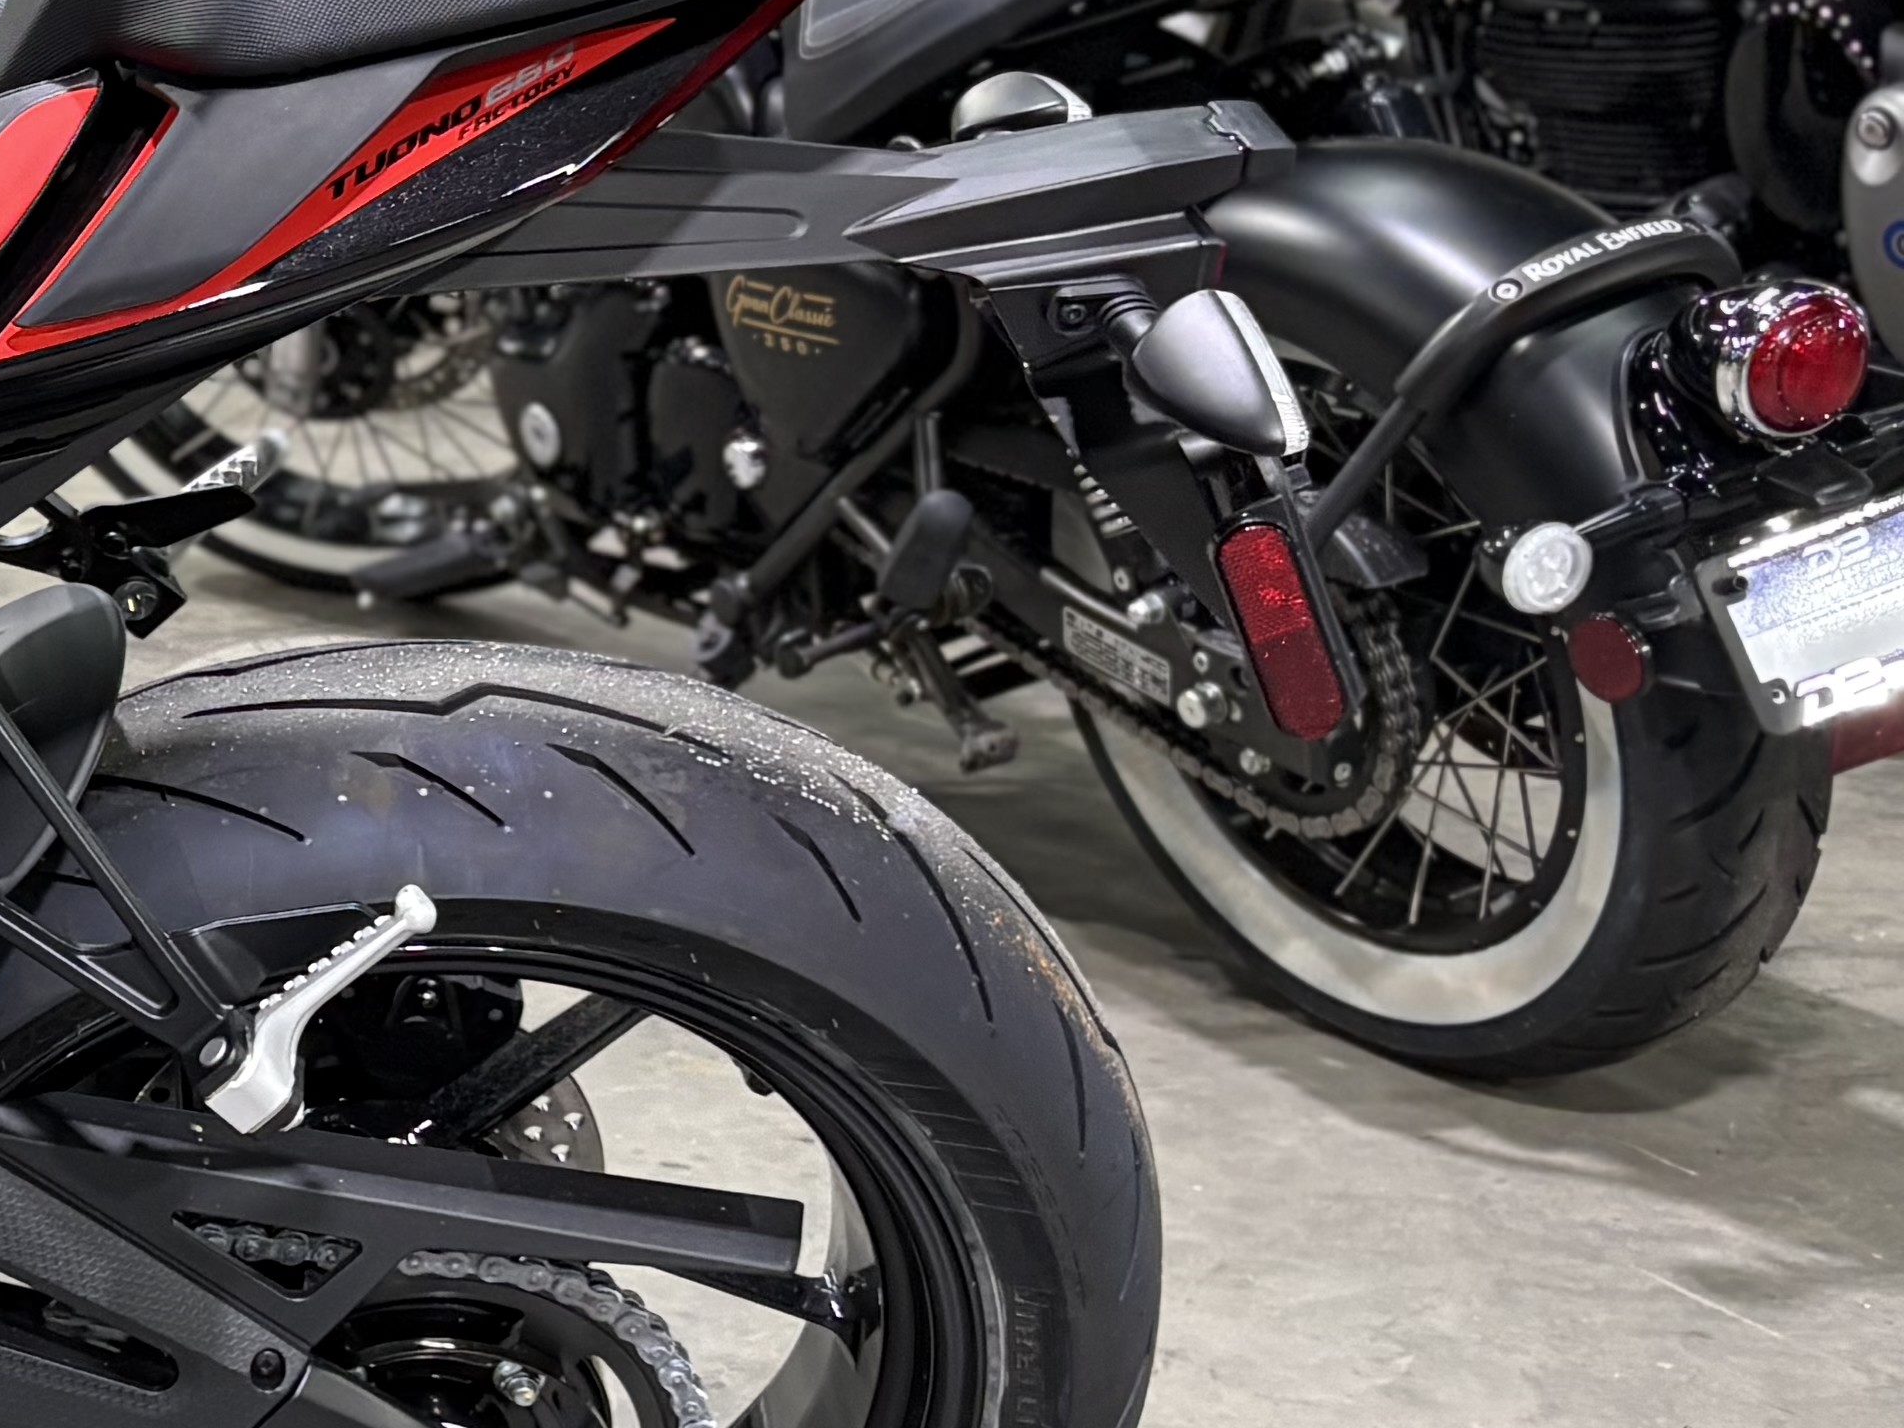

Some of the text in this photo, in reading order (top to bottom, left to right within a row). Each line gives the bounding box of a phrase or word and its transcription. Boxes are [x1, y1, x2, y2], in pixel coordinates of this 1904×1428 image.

[457, 61, 576, 141] FACTORY
[1521, 219, 1683, 282] ROYAL ENFIELD
[770, 286, 834, 327] Classic
